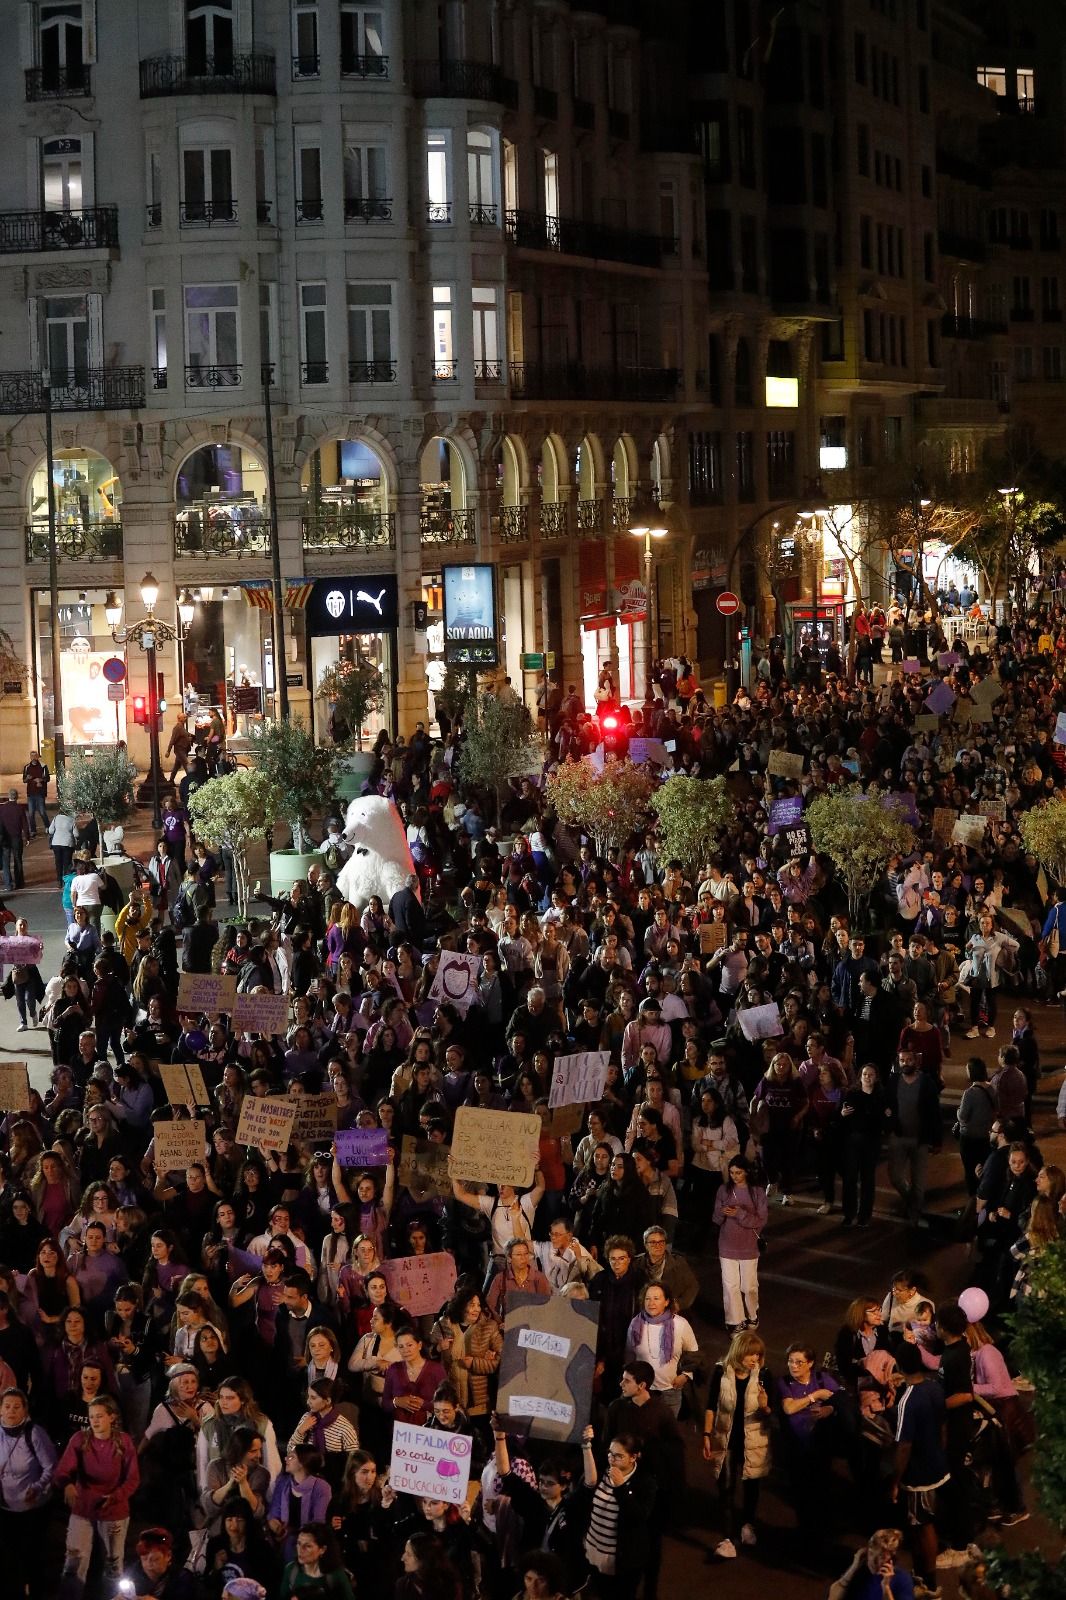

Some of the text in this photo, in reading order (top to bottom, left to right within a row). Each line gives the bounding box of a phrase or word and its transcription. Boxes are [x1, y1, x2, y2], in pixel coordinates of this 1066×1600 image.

[446, 627, 466, 640] SOY
[796, 828, 807, 838] ES
[192, 979, 224, 991] SOMOS
[518, 1120, 538, 1135] NO
[159, 1148, 199, 1158] ABANS QUE
[395, 1429, 467, 1454] MI FALDA NO
[395, 1448, 436, 1463] es corta
[404, 1462, 418, 1474] TU
